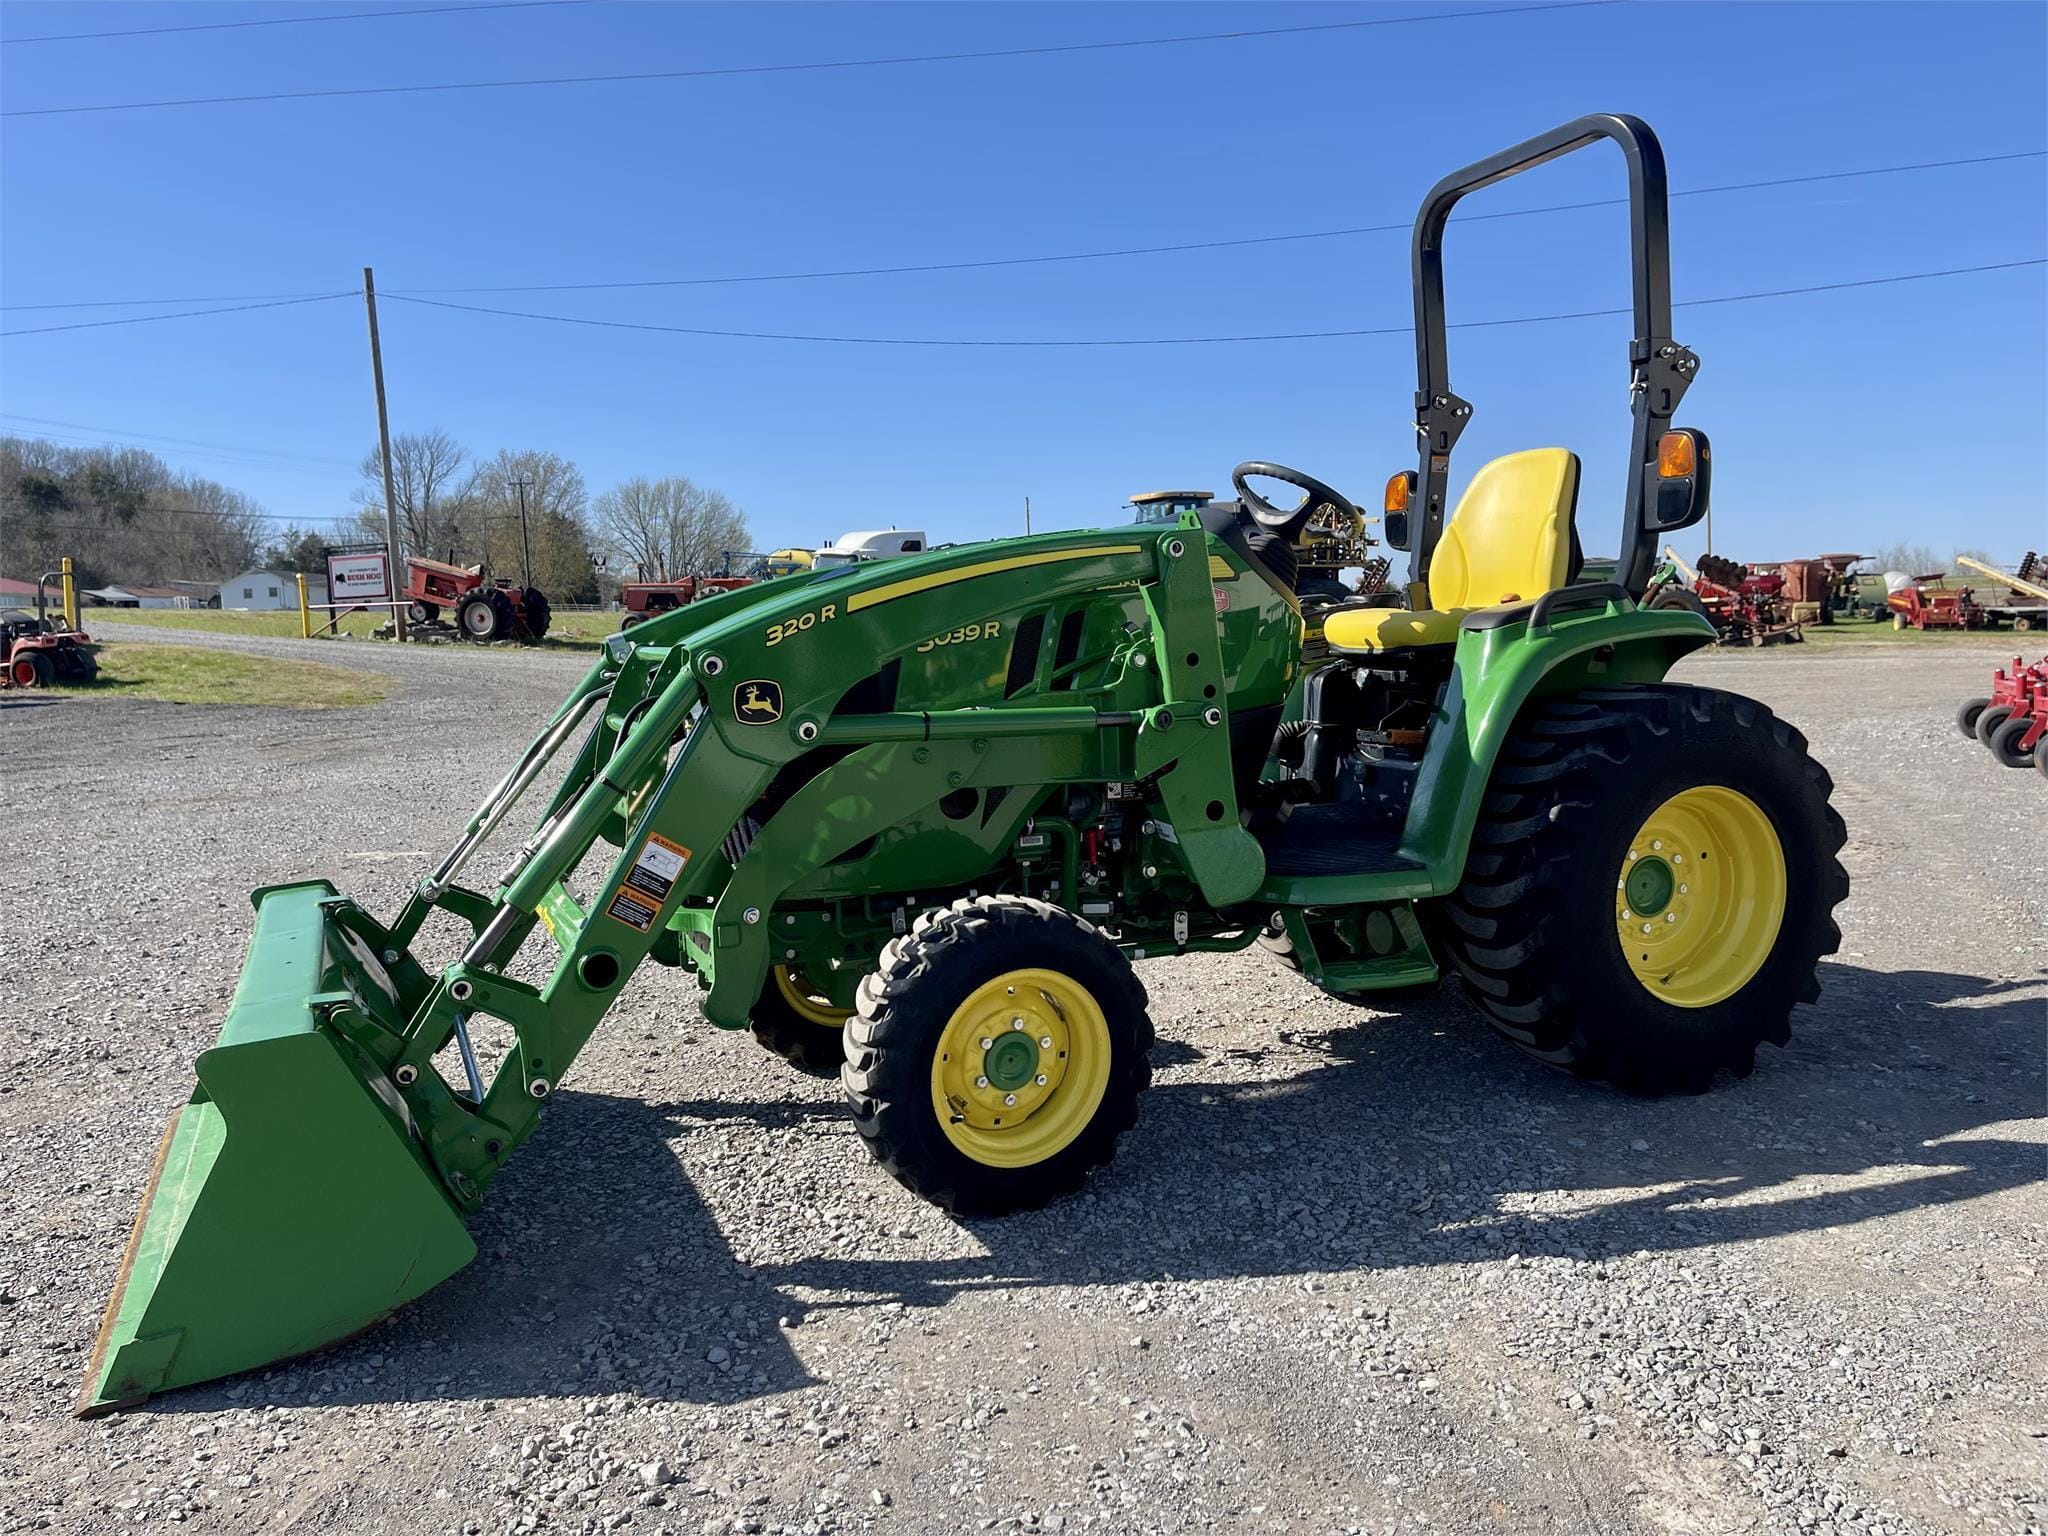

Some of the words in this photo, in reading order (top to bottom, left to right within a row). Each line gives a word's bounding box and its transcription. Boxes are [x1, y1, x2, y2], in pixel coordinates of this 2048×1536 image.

[366, 572, 382, 580] HOG
[766, 612, 816, 647] 320
[821, 604, 836, 623] R
[984, 621, 1001, 639] R
[659, 840, 686, 855] WARNING
[629, 892, 657, 909] WARNING
